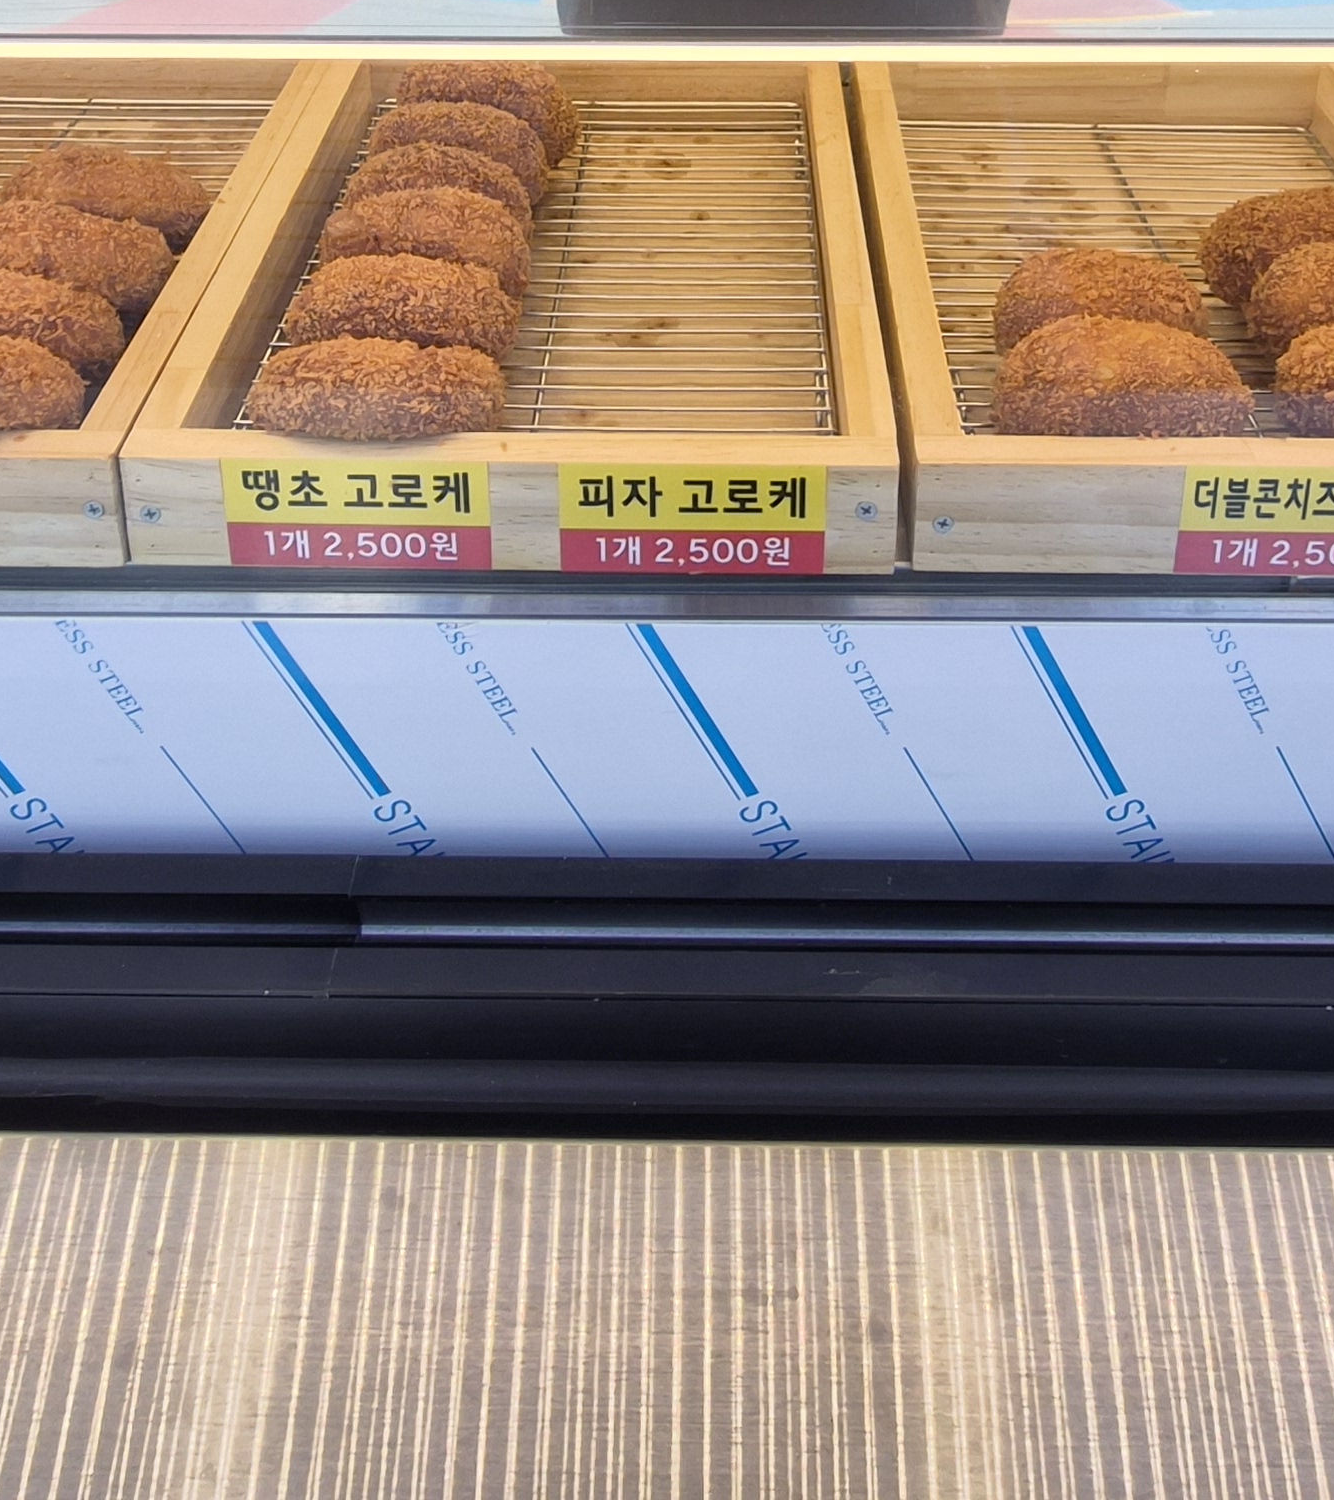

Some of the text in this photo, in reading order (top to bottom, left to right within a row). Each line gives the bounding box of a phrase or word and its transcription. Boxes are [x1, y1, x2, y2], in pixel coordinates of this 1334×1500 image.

[241, 469, 472, 515] 땡초 고로케
[578, 474, 808, 519] 피자 고로케
[264, 529, 460, 562] 1개 2,500원
[595, 535, 791, 567] 1개 2,500원
[1212, 538, 1258, 568] 1개
[88, 659, 147, 722] STEEL
[466, 660, 519, 725] STEEL
[846, 660, 895, 723] STEEL
[1225, 660, 1271, 725] STEEL
[10, 797, 85, 853] STA
[374, 799, 445, 856] STA
